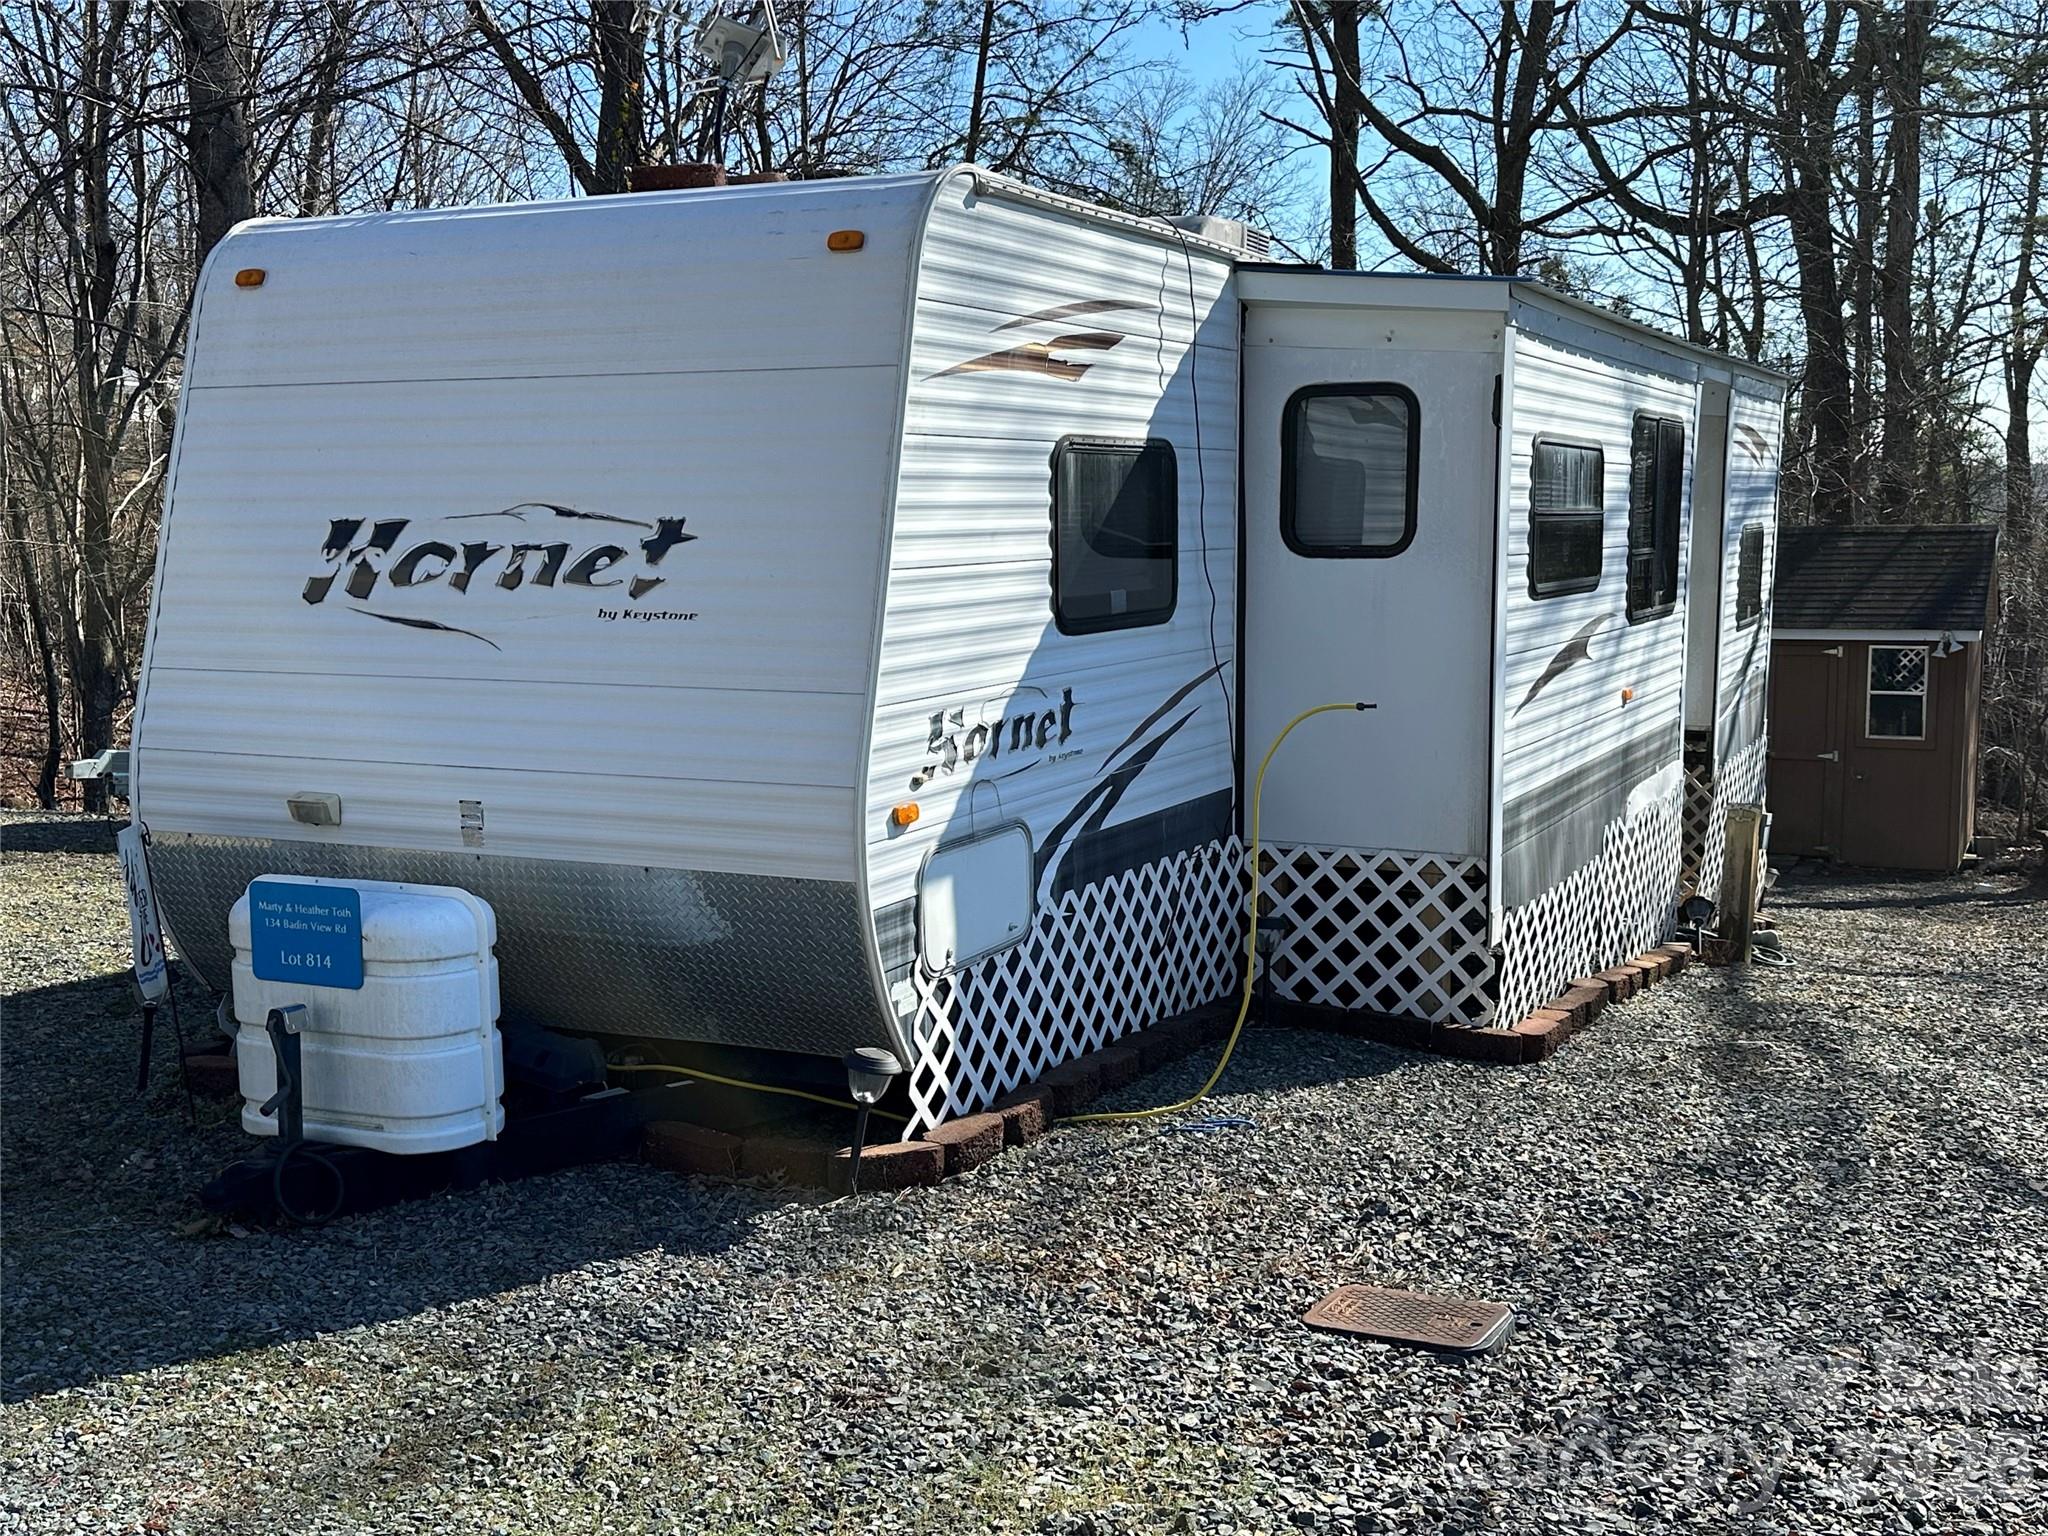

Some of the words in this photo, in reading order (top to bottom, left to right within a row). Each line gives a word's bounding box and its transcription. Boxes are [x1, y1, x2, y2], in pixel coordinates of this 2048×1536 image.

[302, 517, 698, 605] Hornet
[597, 608, 618, 621] by
[622, 608, 699, 622] Keystone
[909, 686, 1085, 792] Hornet
[258, 901, 283, 914] Marty
[285, 903, 293, 913] &
[294, 903, 329, 916] Heather
[332, 906, 352, 918] Toth
[264, 918, 281, 928] 134
[283, 919, 308, 930] Badin
[310, 921, 332, 933] View
[334, 923, 347, 934] Rd
[281, 950, 301, 966] Lot
[306, 953, 332, 969] 814
